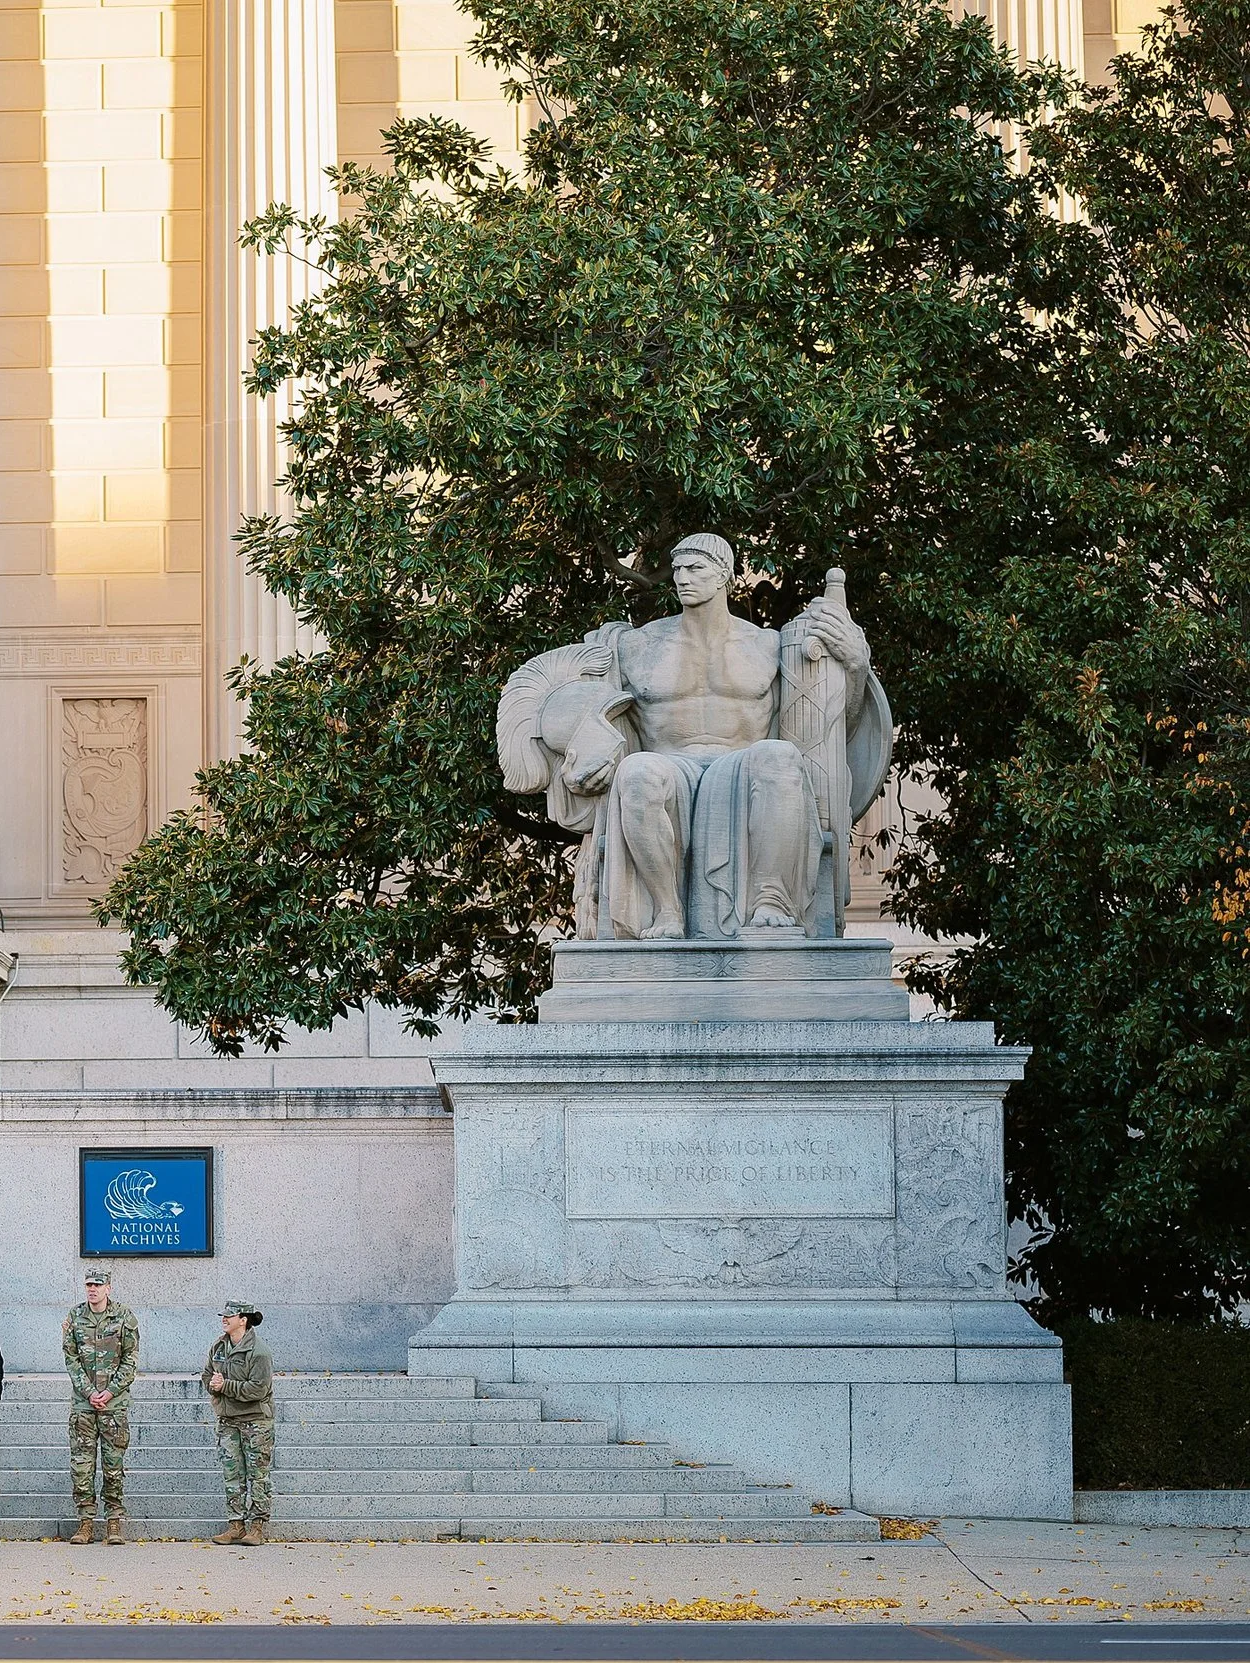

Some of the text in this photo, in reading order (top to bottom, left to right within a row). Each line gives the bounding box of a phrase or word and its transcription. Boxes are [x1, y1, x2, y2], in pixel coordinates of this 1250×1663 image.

[626, 1140, 836, 1156] ETERNAL VIGILANCE
[599, 1166, 861, 1182] IS THE PRICE OF LIBERTY
[111, 1222, 180, 1233] NATIONAL
[111, 1234, 180, 1245] ARCHIVES
